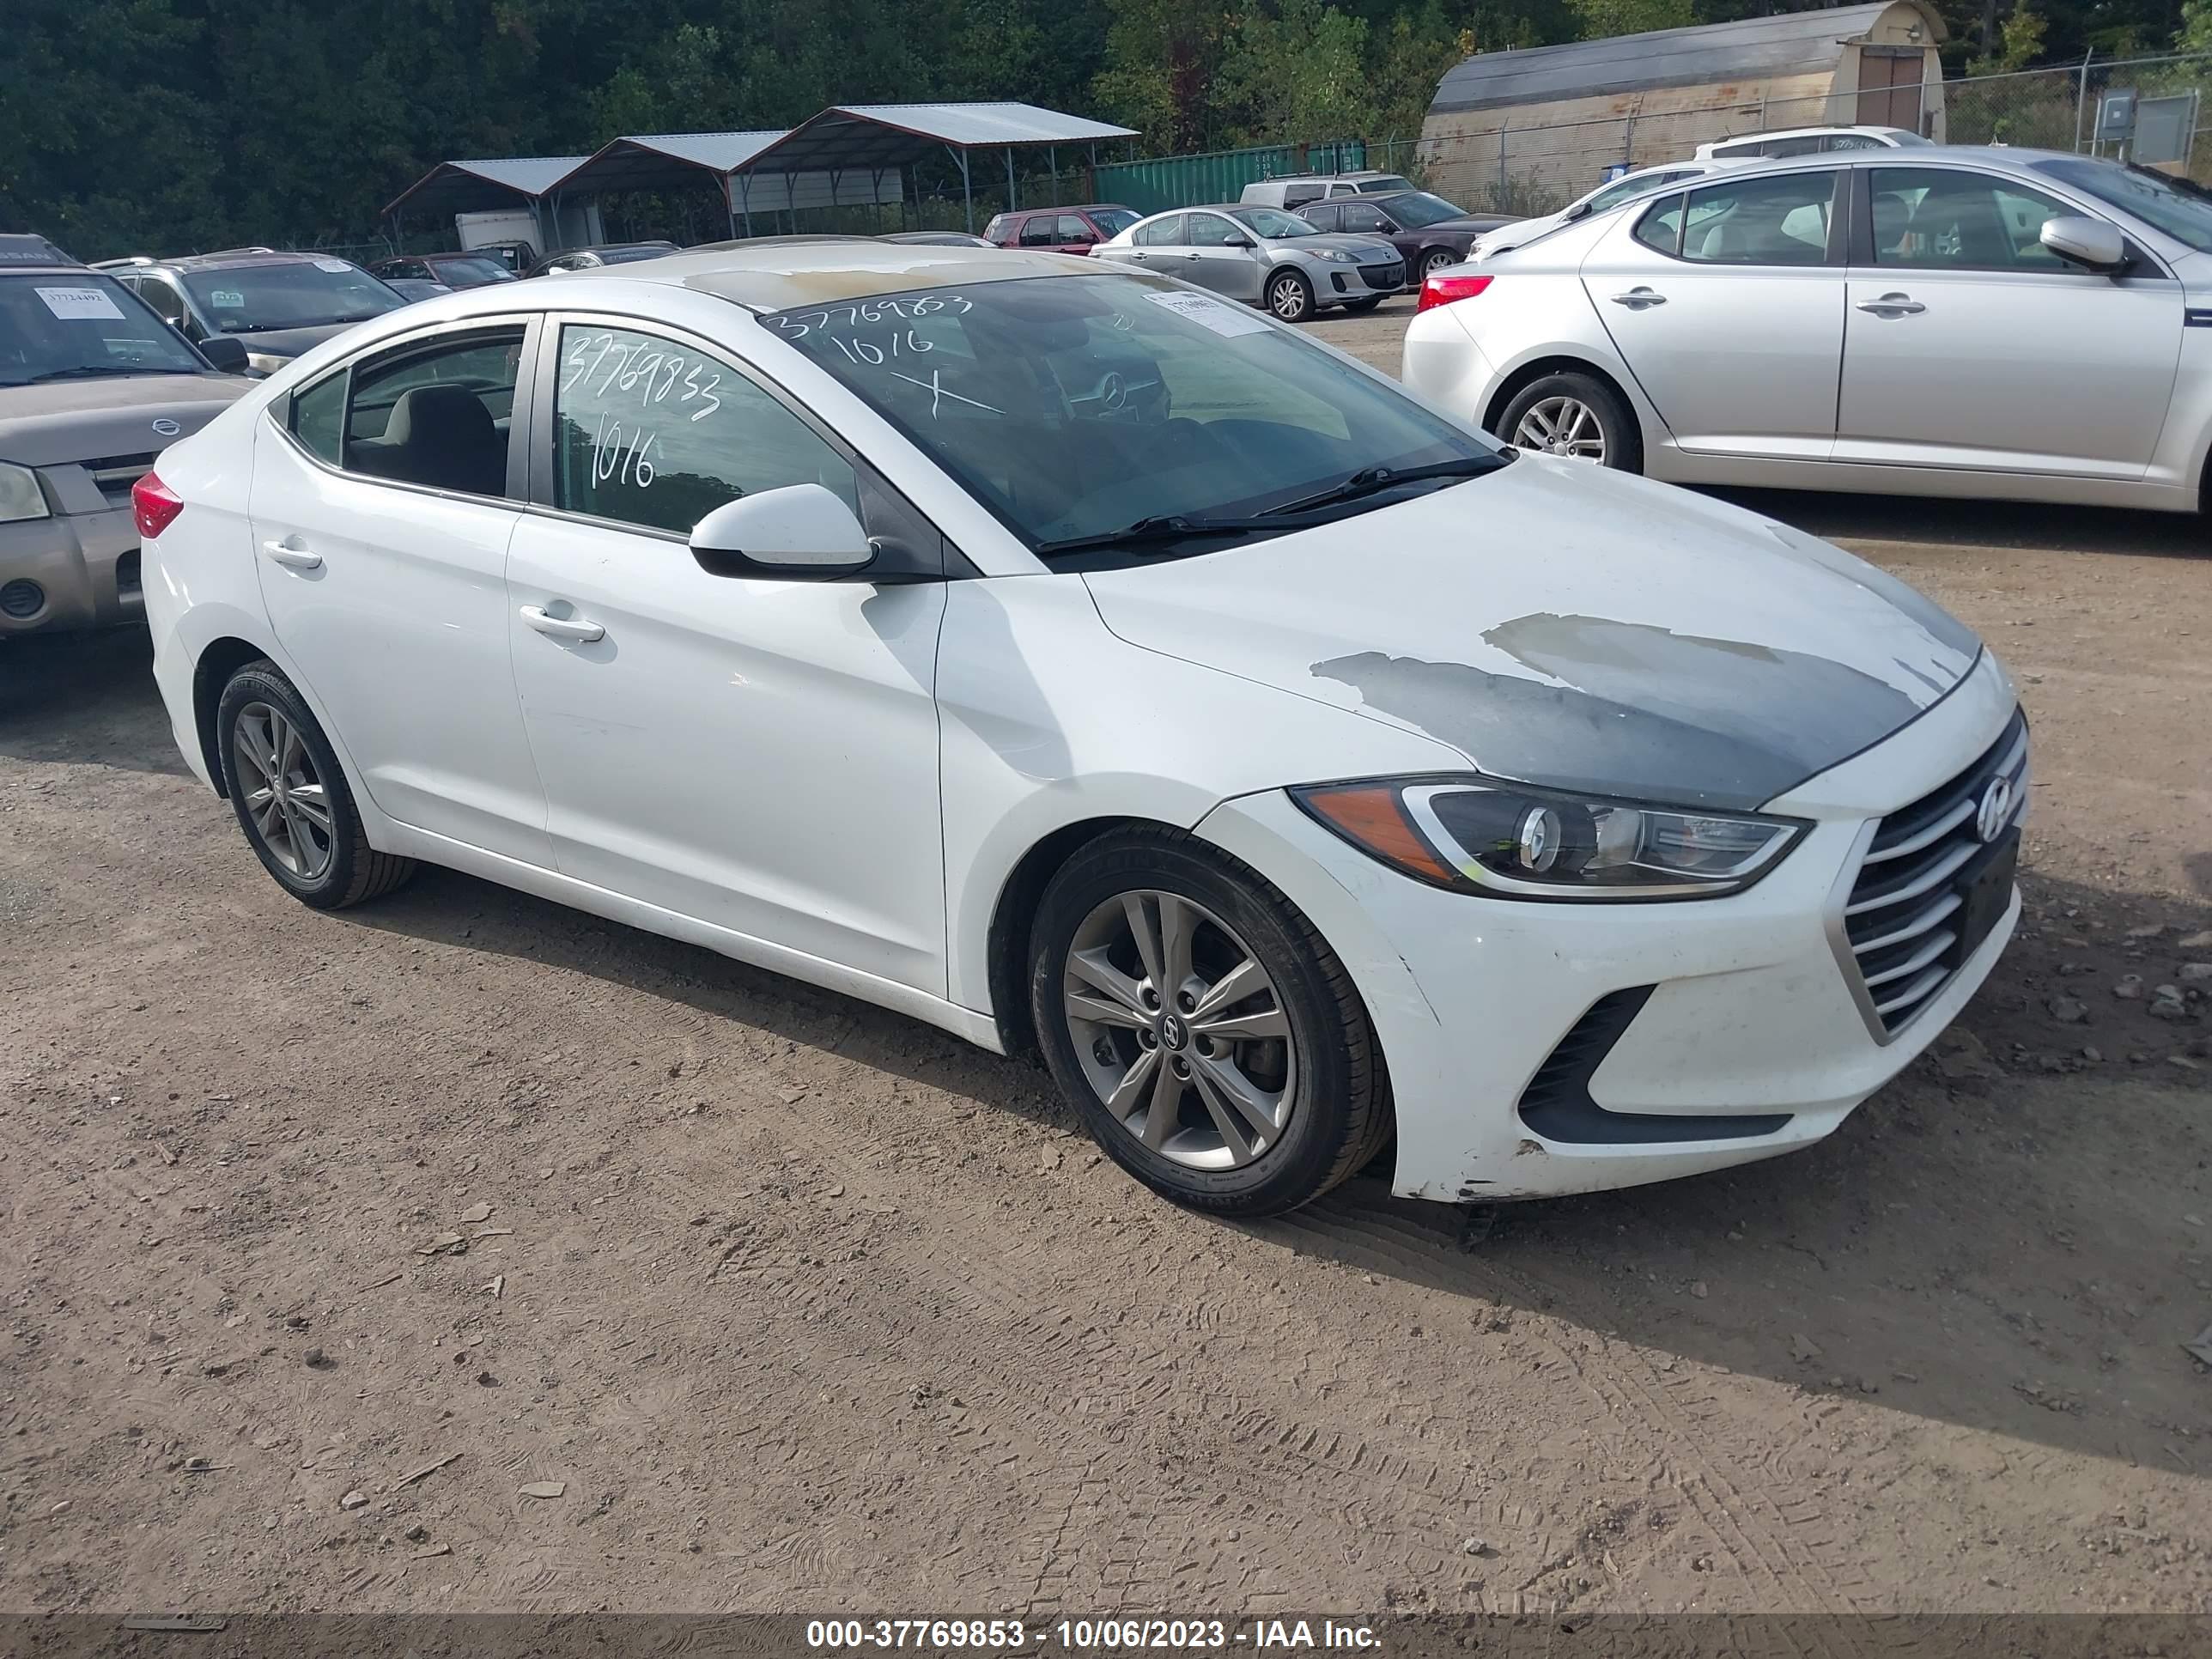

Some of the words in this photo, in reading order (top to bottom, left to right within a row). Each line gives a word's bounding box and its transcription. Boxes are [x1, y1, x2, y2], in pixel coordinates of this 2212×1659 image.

[766, 295, 973, 340] 37769853
[562, 333, 721, 422] 37769853
[592, 410, 656, 489] 1016
